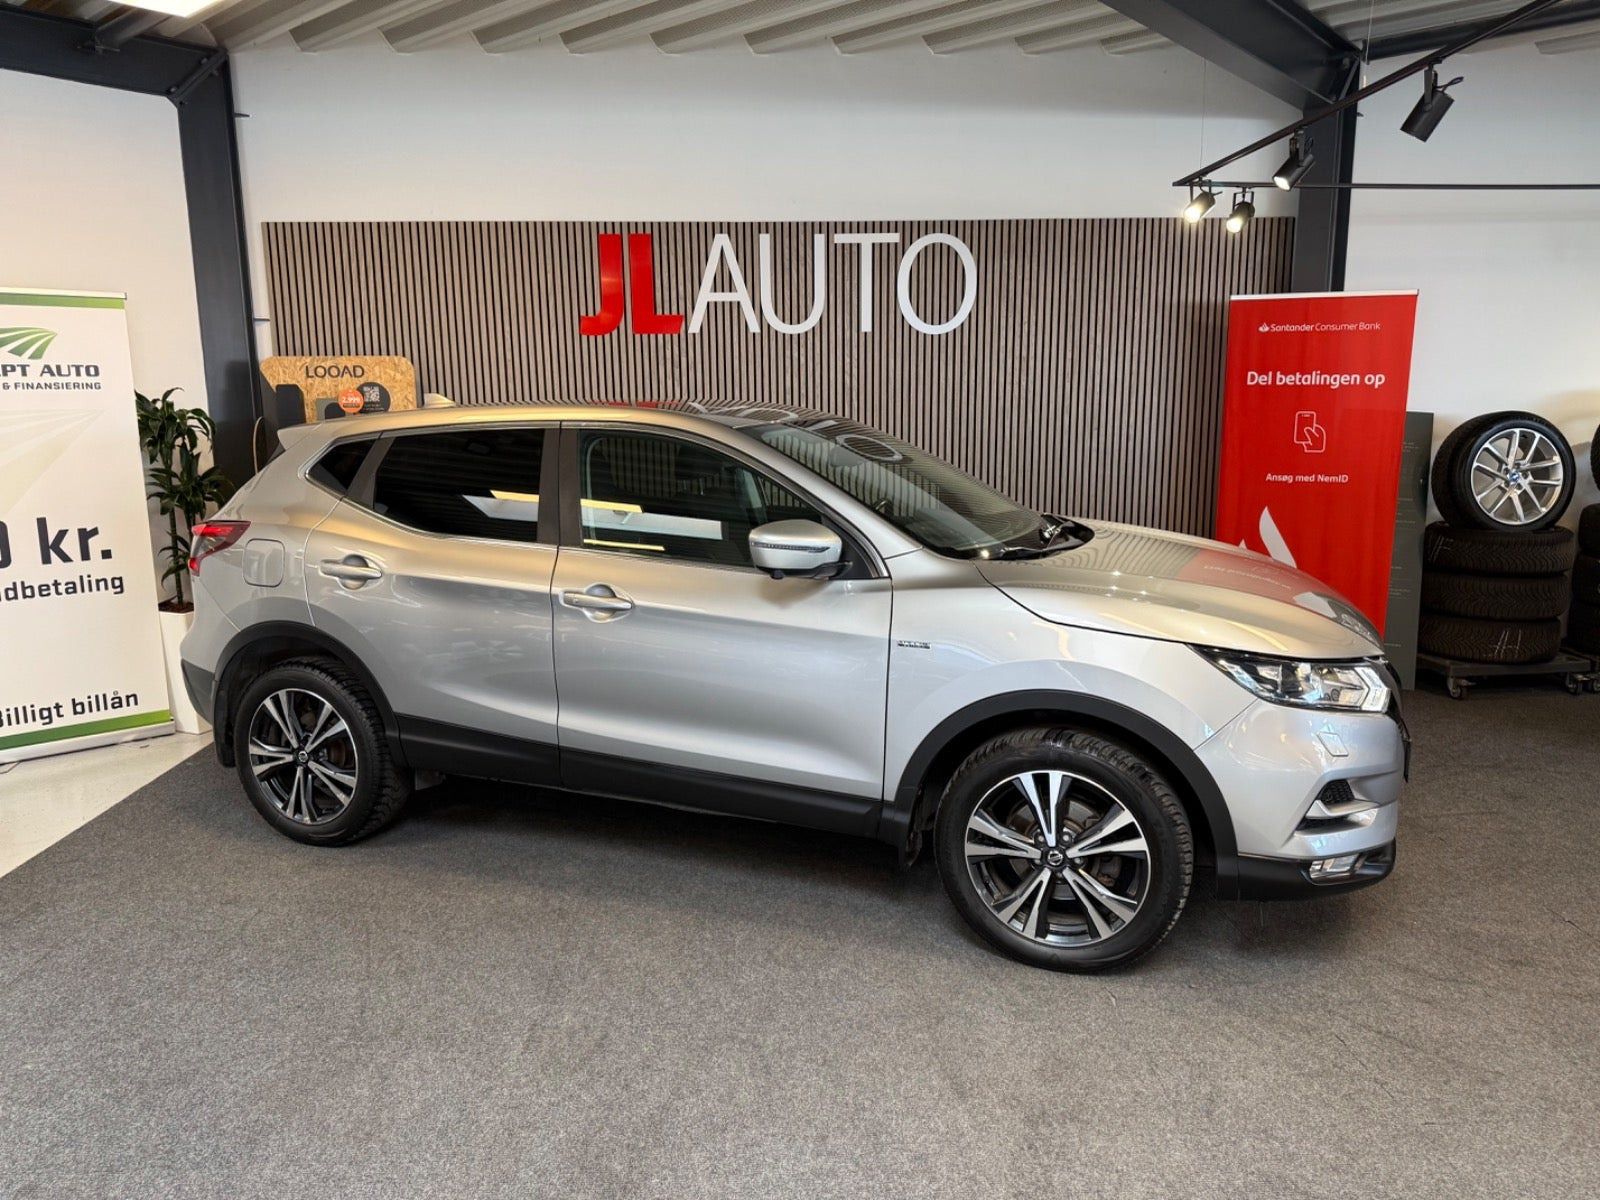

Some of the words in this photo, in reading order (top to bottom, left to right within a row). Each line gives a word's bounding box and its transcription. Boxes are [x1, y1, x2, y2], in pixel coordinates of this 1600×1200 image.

[1270, 323, 1314, 332] Santander
[1315, 322, 1358, 331] Consumer
[1359, 322, 1381, 331] Bank
[0, 364, 30, 377] PT
[40, 364, 100, 377] AUTO
[305, 365, 365, 379] LOOAD
[2, 382, 11, 390] &
[14, 382, 102, 391] FINANSIERING
[1246, 371, 1273, 386] Del
[1276, 370, 1360, 389] betalingen
[1364, 373, 1386, 389] op
[1266, 473, 1293, 484] Ansøg
[1295, 473, 1315, 482] med
[1317, 474, 1349, 483] NemID
[36, 516, 112, 565] kr.
[0, 573, 125, 602] dbetaling
[71, 690, 139, 716] billån
